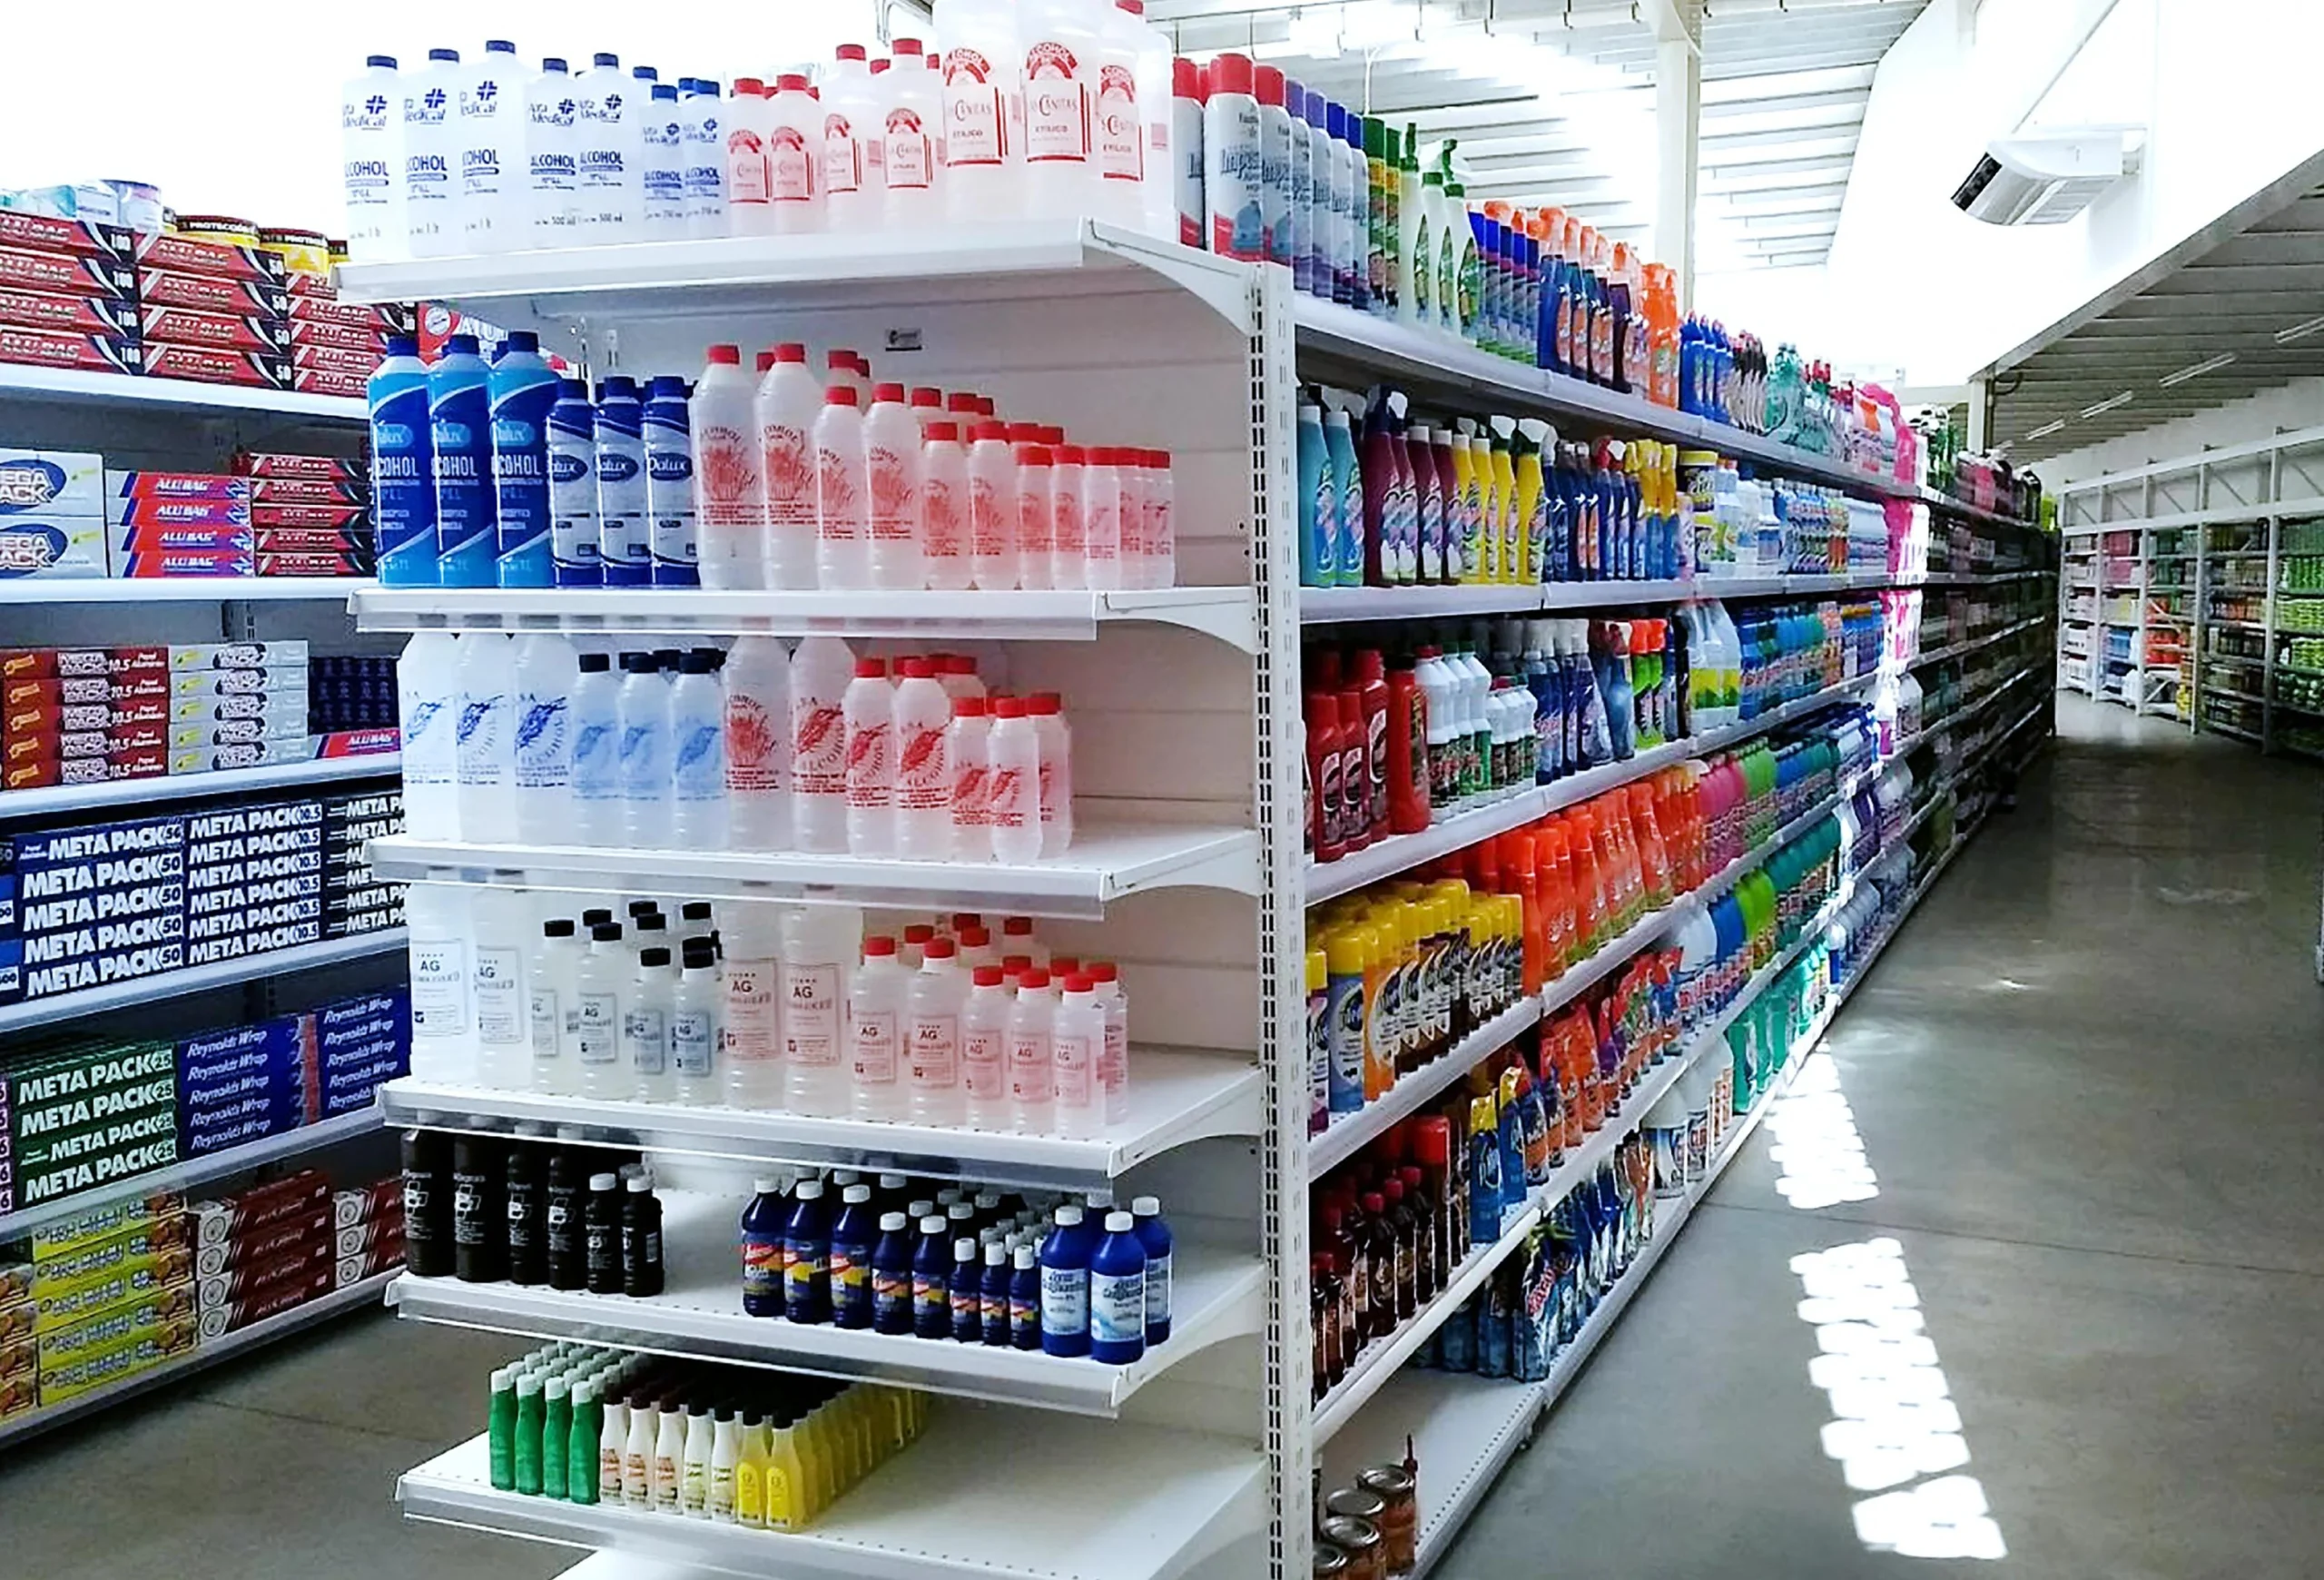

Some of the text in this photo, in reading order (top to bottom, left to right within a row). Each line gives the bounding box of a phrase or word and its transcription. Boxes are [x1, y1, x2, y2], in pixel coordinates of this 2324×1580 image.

[110, 233, 132, 252] 100
[113, 271, 134, 289] 100
[116, 310, 137, 327] 100
[274, 329, 290, 345] 50
[120, 347, 142, 363] 100
[276, 364, 292, 380] 50
[431, 455, 478, 477] COHOL
[491, 454, 543, 476] COHOL
[0, 469, 50, 488] EGA
[0, 487, 54, 504] ACK
[0, 534, 51, 551] EGA
[0, 549, 54, 568] ACK
[346, 796, 389, 818] META
[189, 814, 247, 840] META
[248, 805, 299, 832] PACK
[346, 820, 389, 842] META
[48, 833, 110, 861] META
[111, 825, 164, 853] PACK
[188, 837, 245, 865] META
[246, 830, 298, 855] PACK
[23, 854, 182, 900] META PACK 50
[187, 863, 245, 890] META
[246, 854, 298, 880] PACK
[346, 866, 373, 888] MET
[189, 887, 246, 915] META
[247, 877, 298, 904] PACK
[346, 886, 389, 910] META
[24, 885, 182, 933] META PACK 50
[189, 912, 246, 941] META
[246, 902, 298, 929] PACK
[346, 909, 389, 933] META
[24, 916, 182, 964] META PACK 50
[188, 936, 246, 965] META
[246, 925, 297, 953] PACK
[27, 946, 182, 997] META PACK 50
[419, 960, 441, 973] AG
[732, 980, 753, 993] AG
[793, 985, 813, 999] AG
[861, 1026, 879, 1037] AG
[17, 1069, 89, 1106] META
[90, 1055, 153, 1088] PACK
[20, 1100, 92, 1139] META
[93, 1082, 156, 1119] PACK
[50, 1131, 107, 1163] META
[107, 1115, 159, 1146] PACK
[25, 1163, 95, 1204] META
[95, 1143, 158, 1181] PACK
